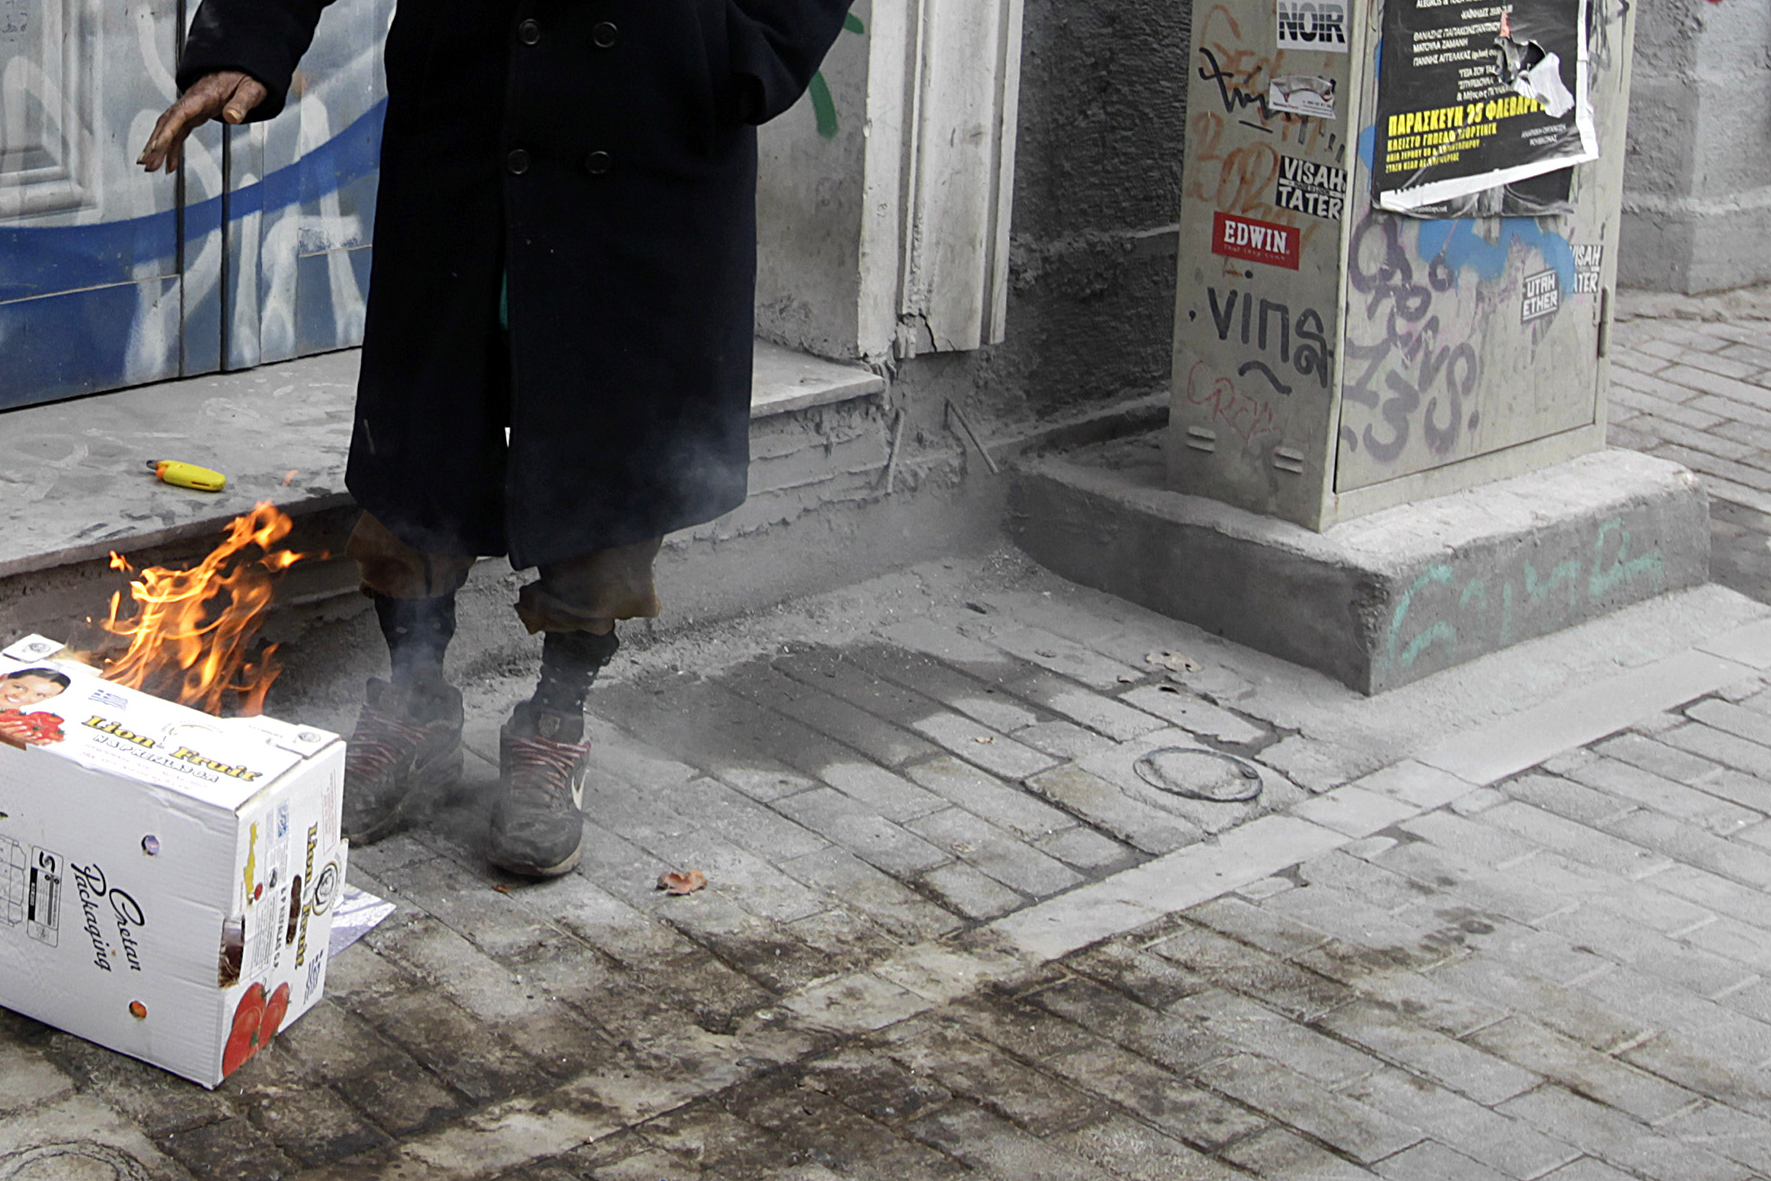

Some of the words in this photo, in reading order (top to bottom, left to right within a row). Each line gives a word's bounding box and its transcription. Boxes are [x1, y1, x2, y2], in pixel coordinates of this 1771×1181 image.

[1279, 2, 1346, 44] NOIR
[1388, 105, 1464, 137] ΠΑΡΑΣΚΕΥΗ
[1387, 136, 1420, 152] ΚΛΕΙΣΤΟ
[1284, 156, 1344, 192] VISAH
[1278, 186, 1342, 220] TATER
[1223, 220, 1288, 254] EDWIN
[1523, 289, 1558, 316] ETHER
[1527, 273, 1556, 298] UTAH
[81, 715, 156, 749] Lion
[169, 745, 263, 782] Fruit
[304, 821, 318, 887] Lion
[71, 863, 113, 973] Packaging
[109, 888, 146, 972] Cretan
[294, 904, 313, 970] Fruit
